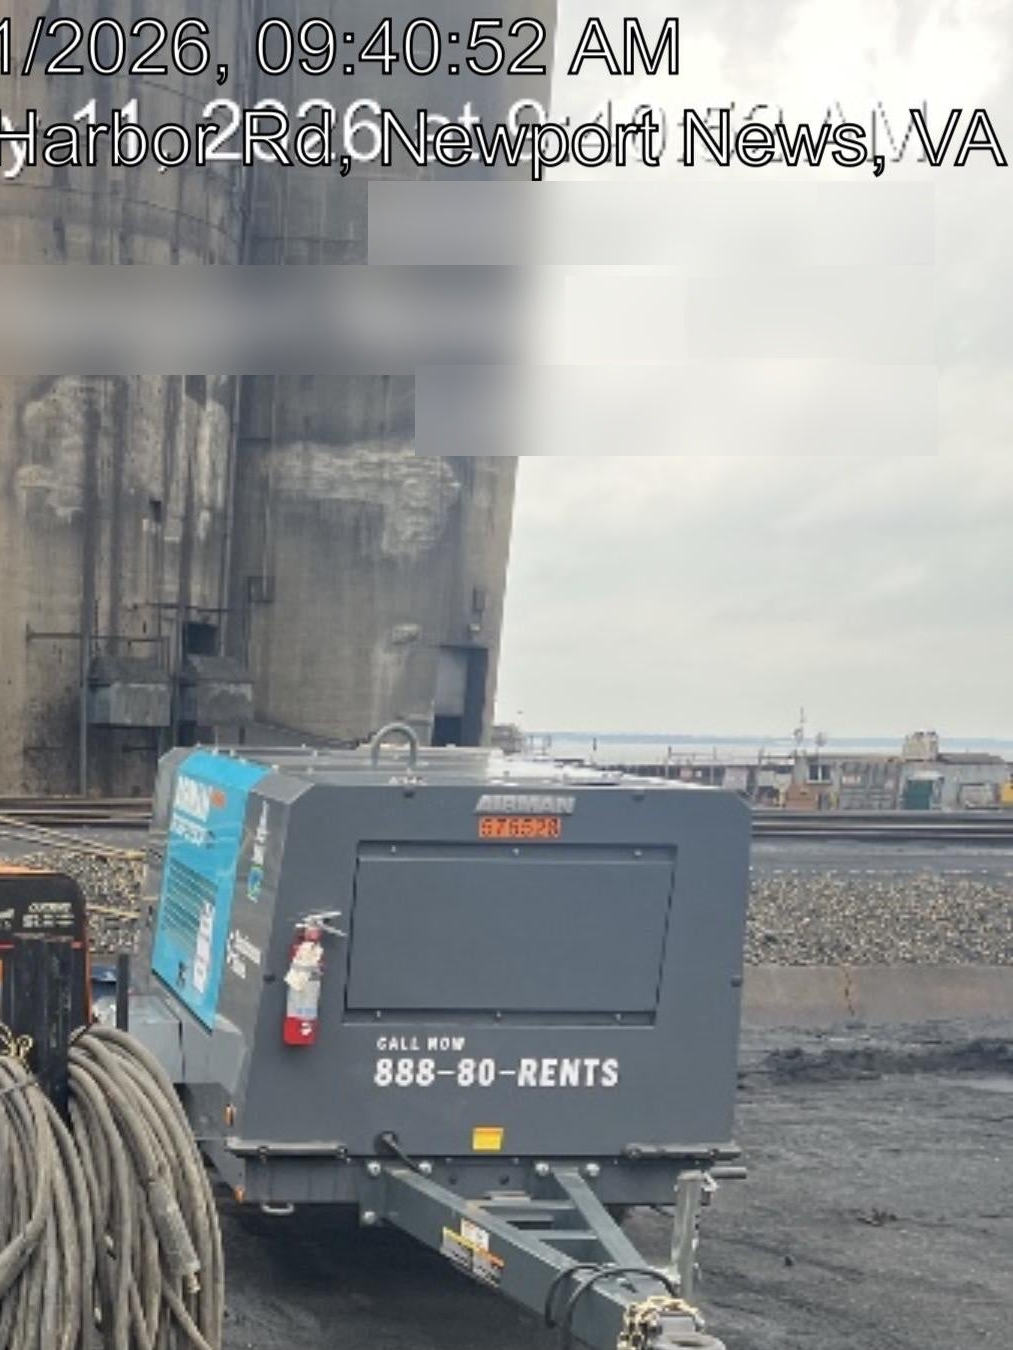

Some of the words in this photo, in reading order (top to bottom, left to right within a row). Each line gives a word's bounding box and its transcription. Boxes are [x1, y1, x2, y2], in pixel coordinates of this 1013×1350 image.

[475, 795, 576, 814] AIRMAN
[376, 1037, 420, 1051] CALL
[427, 1037, 466, 1051] NOW
[374, 1058, 619, 1087] 888-80-RENTS
